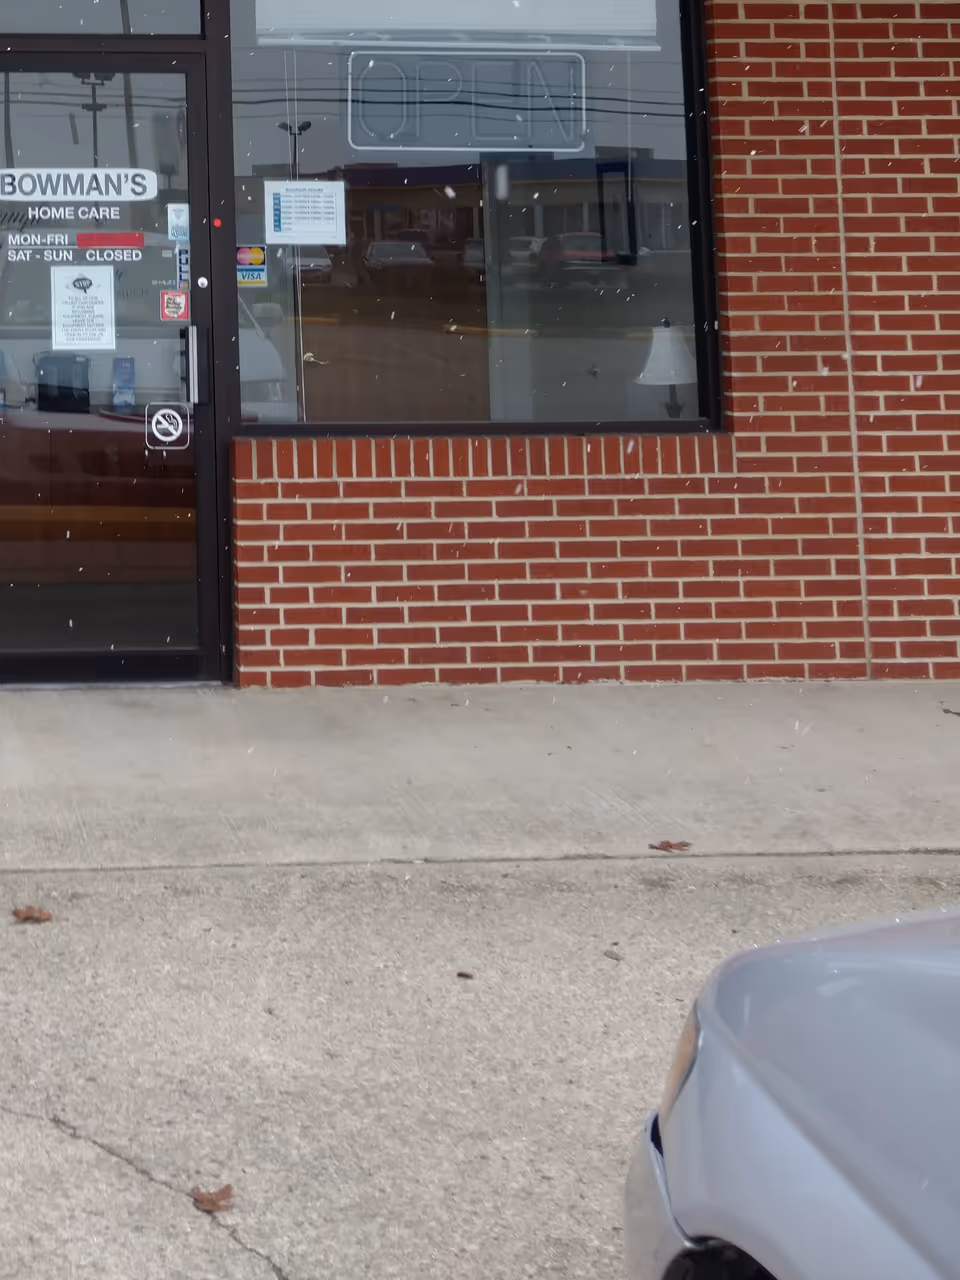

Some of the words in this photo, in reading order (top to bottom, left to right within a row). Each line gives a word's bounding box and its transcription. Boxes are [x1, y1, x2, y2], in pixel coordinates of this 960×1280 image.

[358, 60, 574, 143] OPEN
[0, 173, 147, 196] BOWMAN'S
[28, 207, 74, 220] HOME
[78, 207, 120, 220] CARE
[8, 233, 69, 246] MON-FRI
[8, 250, 32, 262] SAT
[43, 250, 73, 261] SUN
[85, 250, 142, 261] CLOSED
[241, 272, 262, 281] VISA
